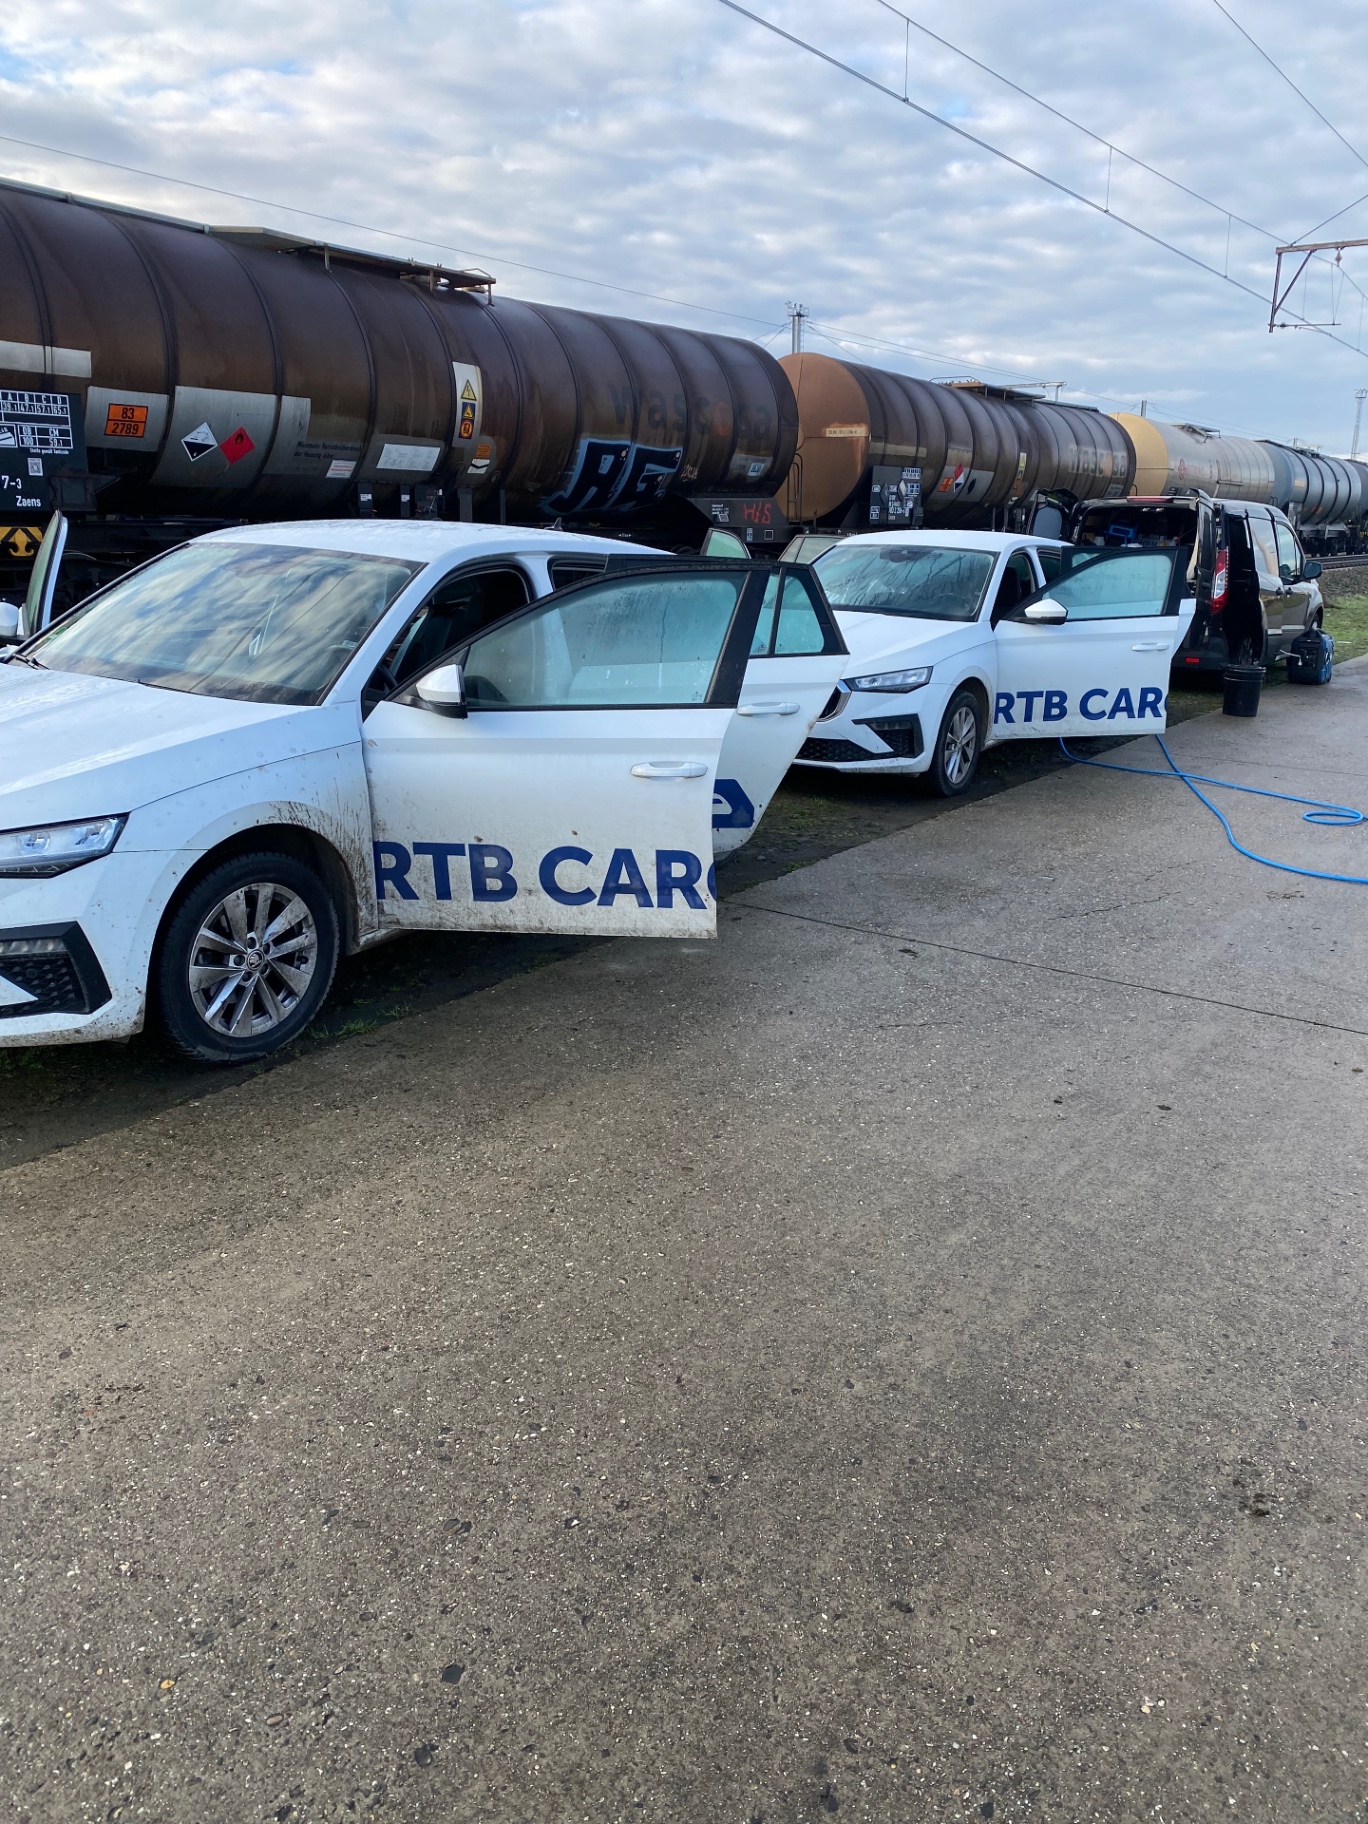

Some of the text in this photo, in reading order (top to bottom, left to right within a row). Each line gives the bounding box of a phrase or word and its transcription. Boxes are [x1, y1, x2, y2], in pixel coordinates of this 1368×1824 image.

[121, 407, 135, 420] 83
[111, 422, 139, 435] 2789
[16, 495, 41, 507] Zaens
[994, 690, 1068, 724] RTB
[373, 841, 718, 910] RTB CAR
